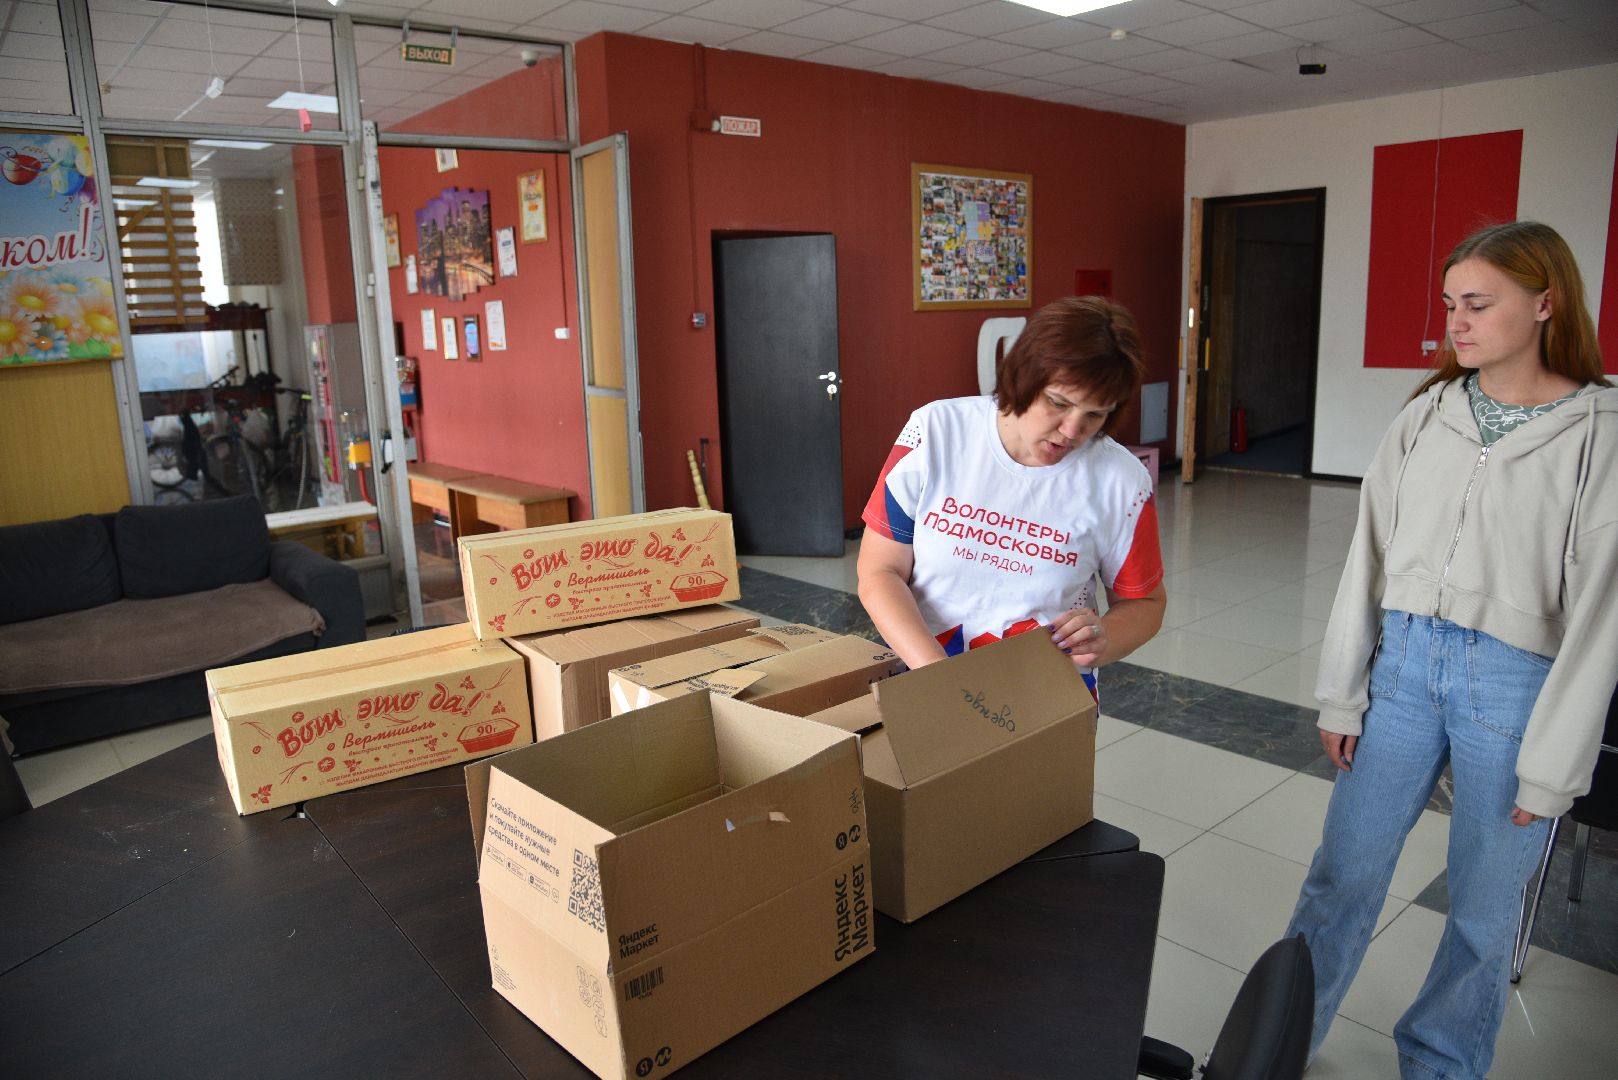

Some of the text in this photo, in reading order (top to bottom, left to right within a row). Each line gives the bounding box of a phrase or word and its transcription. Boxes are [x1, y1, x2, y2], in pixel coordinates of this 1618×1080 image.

[408, 47, 449, 63] ВЫХОД
[723, 120, 758, 134] ПОЖАР
[0, 206, 89, 268] ком!
[510, 531, 697, 592] Вот это да!
[567, 567, 653, 588] Вермишель
[952, 546, 1034, 576] МЫ РЯДОМ
[277, 682, 485, 758] Вот это да!
[342, 720, 437, 750] Вермишель
[489, 812, 494, 820] и
[494, 815, 525, 839] покупайте
[525, 835, 551, 856] нужные
[491, 797, 558, 846] Скачайте приложение
[488, 825, 514, 848] средства
[519, 846, 540, 865] одном
[540, 859, 561, 878] месте
[834, 873, 853, 962] Яндекс
[851, 863, 869, 953] Маркет
[618, 923, 658, 947] Яндекс
[619, 934, 660, 960] Маркет
